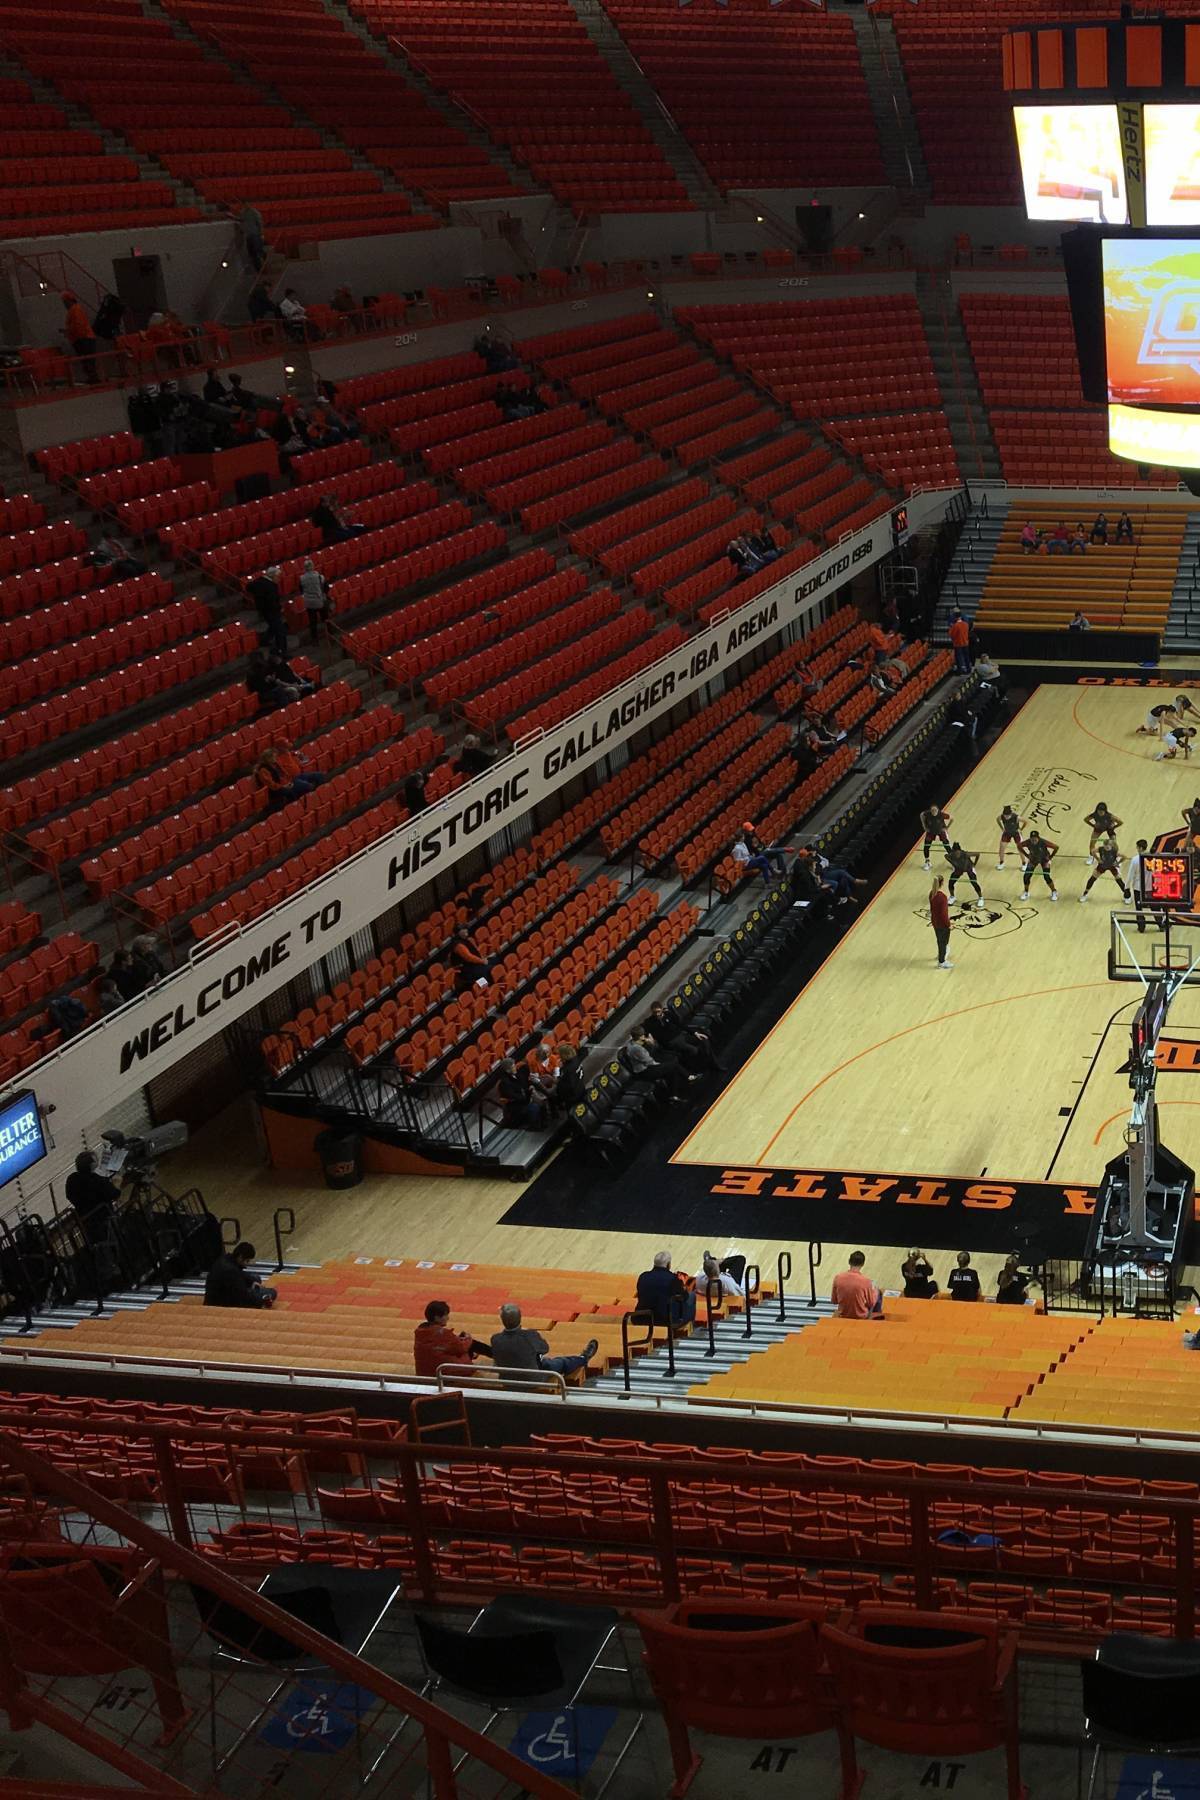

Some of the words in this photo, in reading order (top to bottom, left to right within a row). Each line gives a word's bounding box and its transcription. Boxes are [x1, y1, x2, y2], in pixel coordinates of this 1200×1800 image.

[1122, 106, 1141, 183] Hertz
[395, 333, 417, 346] 204
[120, 931, 291, 1075] WELCOME
[300, 899, 341, 944] TO
[388, 768, 529, 890] HISTORIC
[543, 642, 719, 780] GALLAGHER-IBA
[727, 602, 778, 653] ARENA
[795, 555, 849, 604] DEDICATED
[852, 539, 873, 564] 1938
[1152, 872, 1184, 899] 30
[711, 1169, 1017, 1212] STATE
[95, 1686, 148, 1711] AT
[750, 1746, 798, 1773] AT
[920, 1761, 967, 1790] AT
